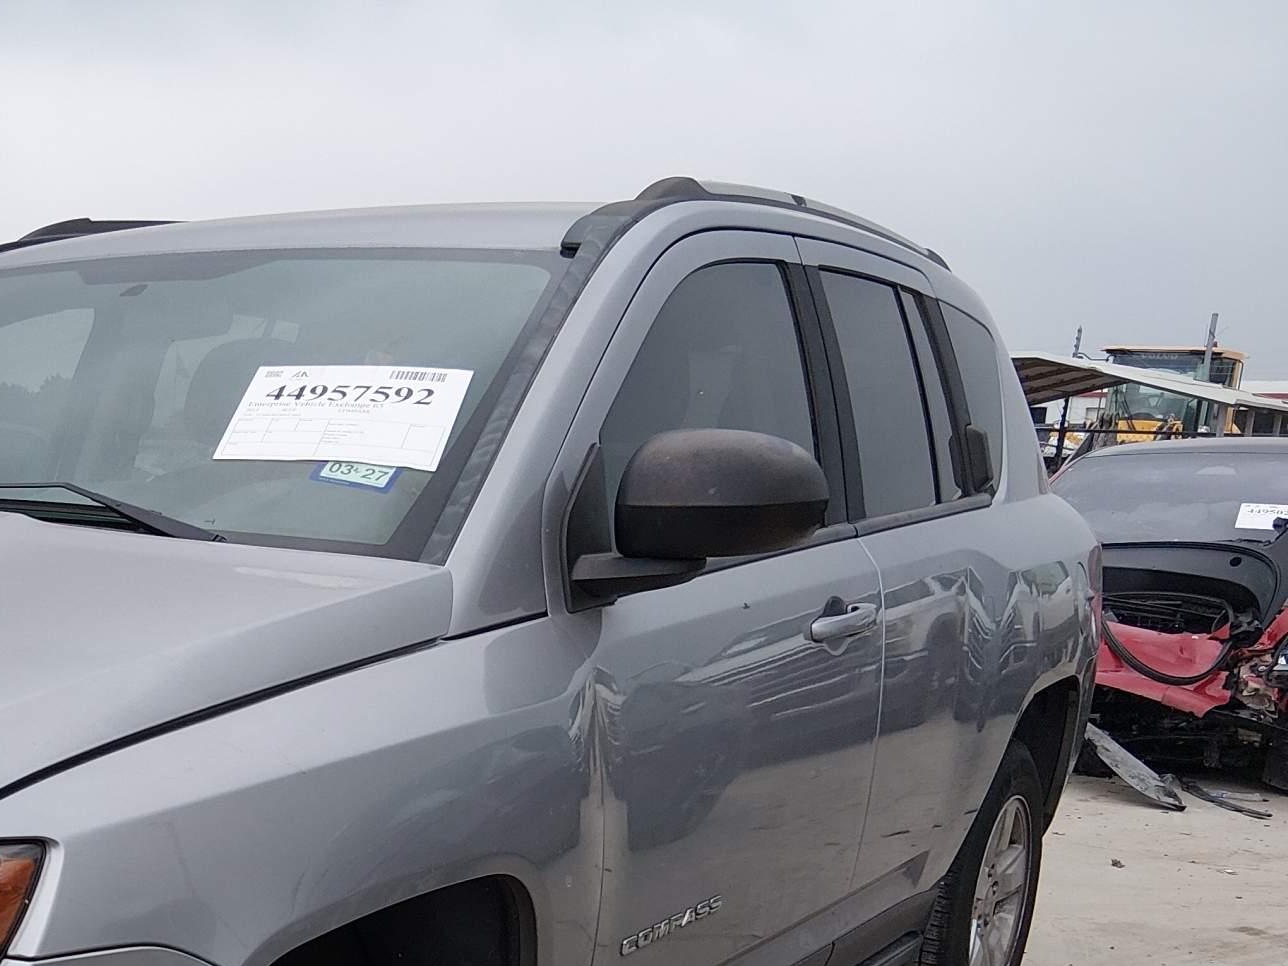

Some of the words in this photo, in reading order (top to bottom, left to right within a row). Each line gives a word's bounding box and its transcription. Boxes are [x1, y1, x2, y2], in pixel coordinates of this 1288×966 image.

[265, 384, 435, 406] 44957592
[328, 462, 354, 475] 03
[360, 468, 389, 481] 27
[620, 895, 723, 957] COMPASS
